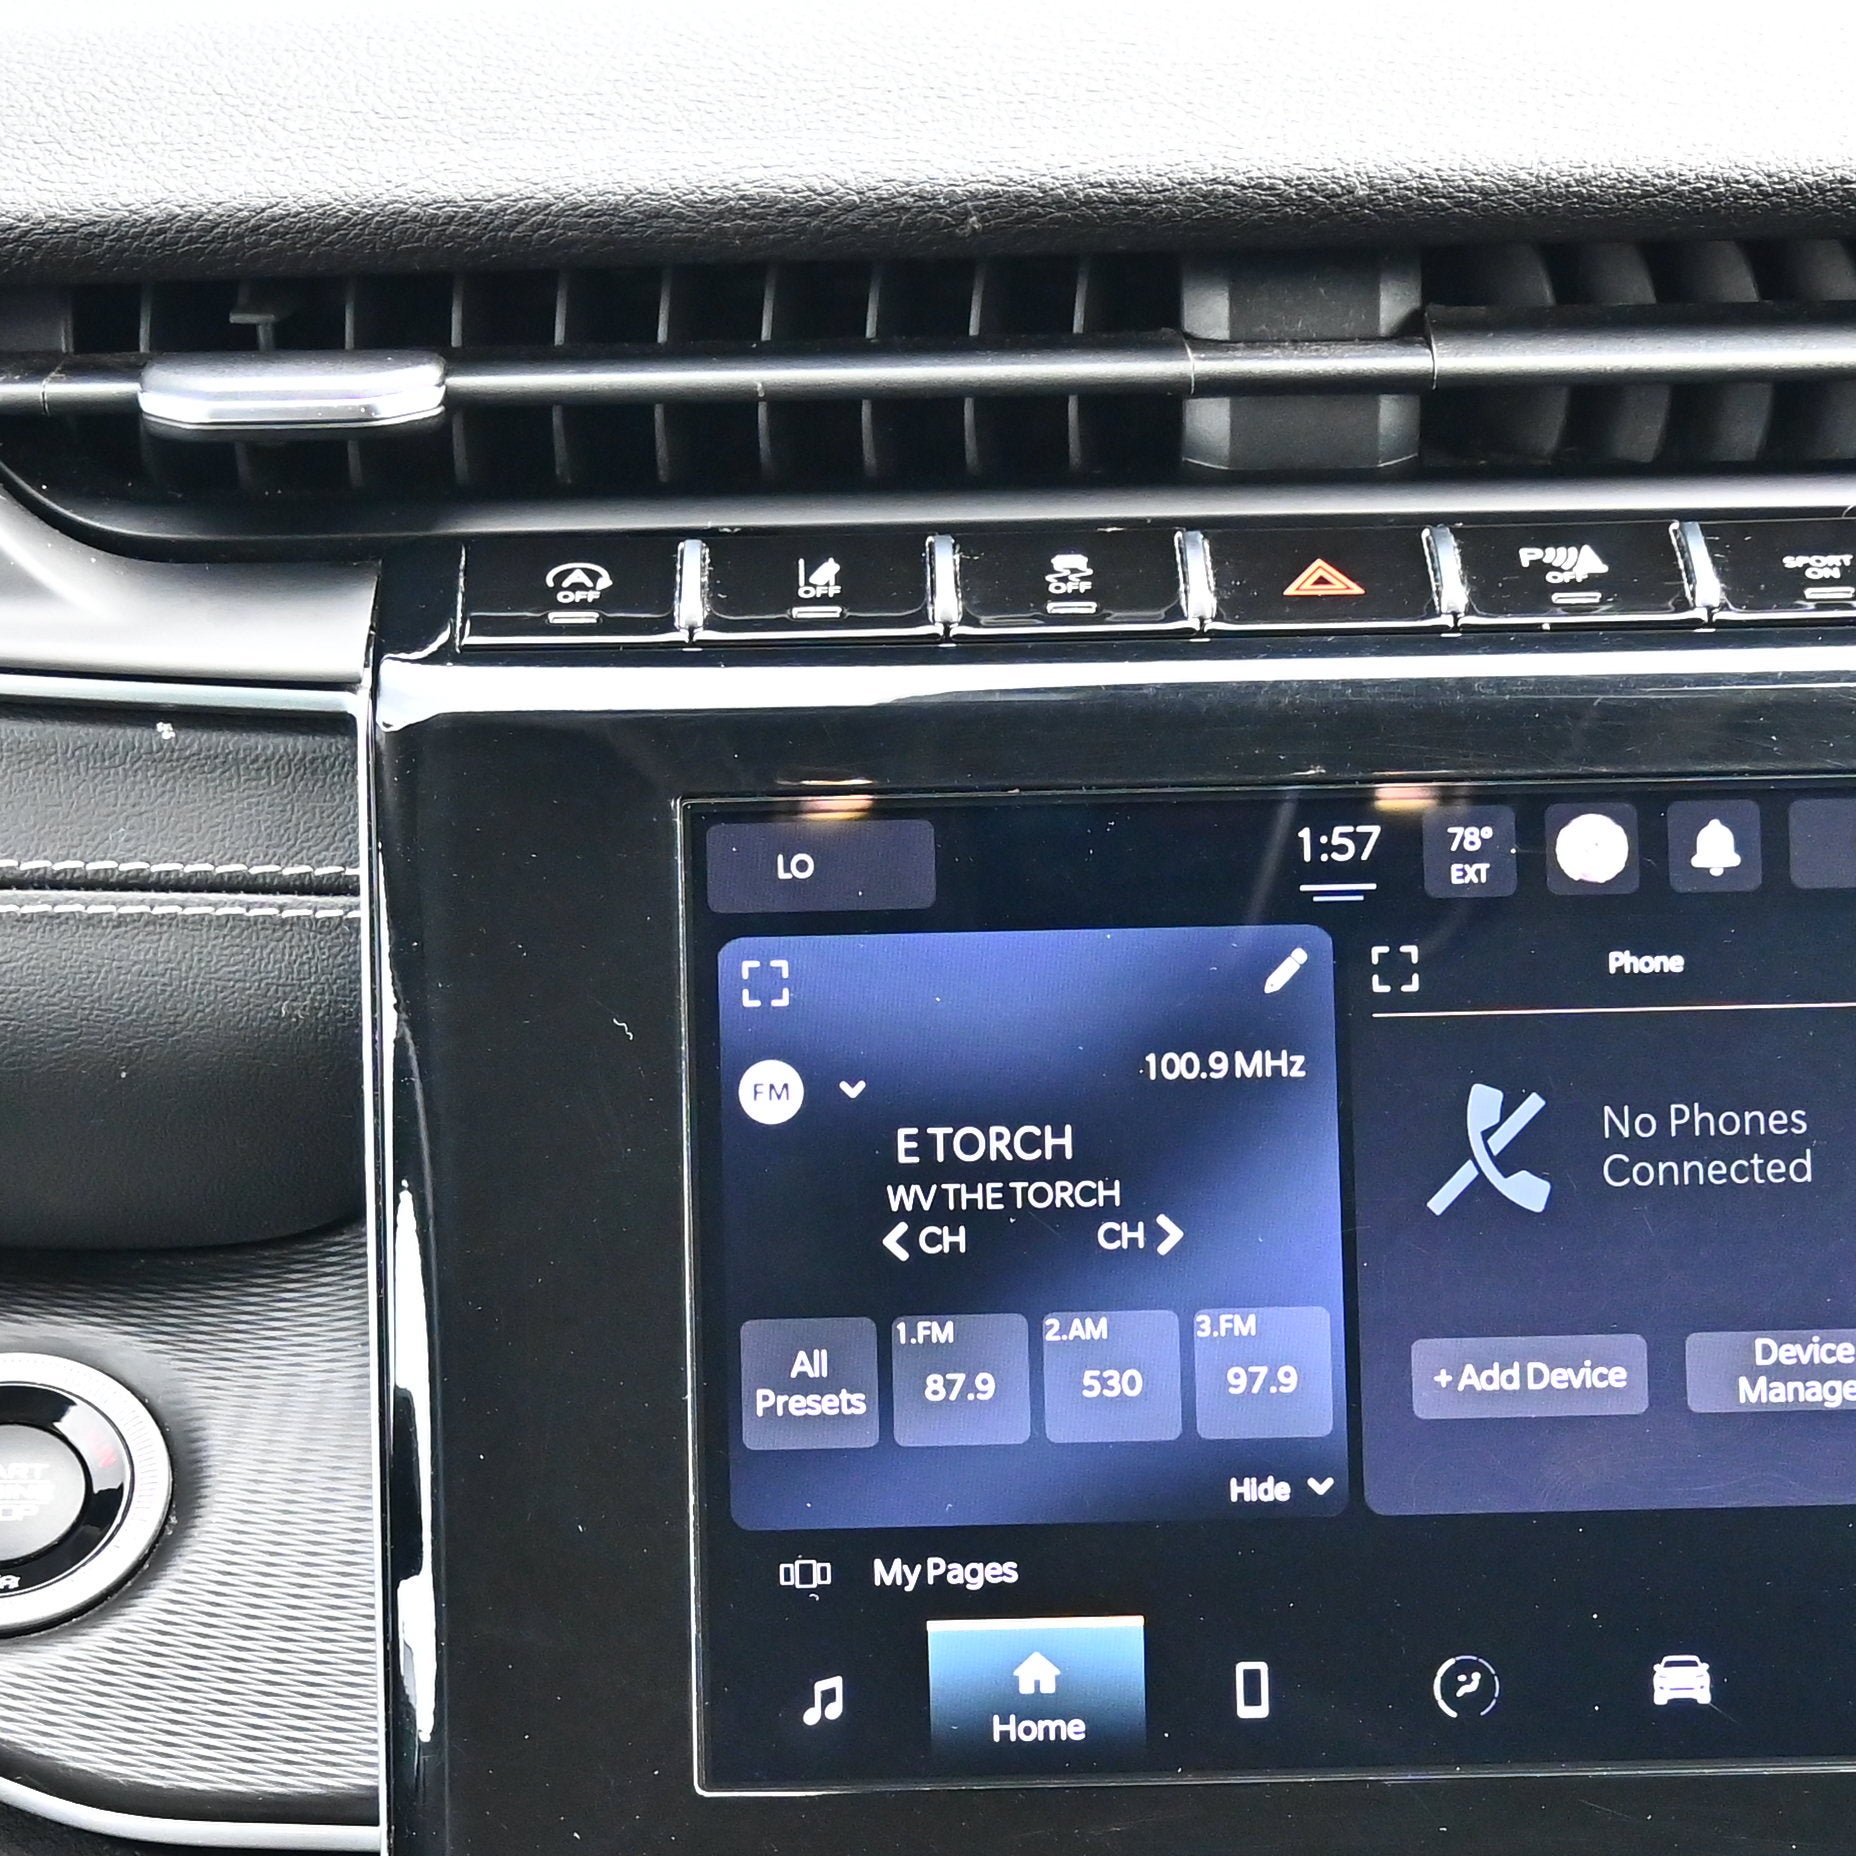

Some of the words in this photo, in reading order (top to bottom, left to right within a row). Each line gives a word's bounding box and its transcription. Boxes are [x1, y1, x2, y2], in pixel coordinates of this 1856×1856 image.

[1782, 554, 1853, 568] SPORT
[1805, 567, 1841, 579] ON
[1048, 581, 1092, 594] OFF
[1545, 571, 1588, 583] OFF
[557, 591, 600, 603] OFF
[798, 585, 841, 599] OFF
[1297, 825, 1381, 865] 1:57
[777, 854, 814, 880] LO
[1451, 863, 1489, 885] EXT
[1608, 950, 1684, 975] Phone
[1144, 1051, 1228, 1081] 100.9
[1234, 1049, 1306, 1078] MHz
[752, 1082, 791, 1103] FM
[1602, 1106, 1657, 1140] No
[1669, 1103, 1808, 1137] Phones
[897, 1127, 918, 1164] E
[928, 1124, 1074, 1162] TORCH
[1602, 1149, 1813, 1188] Connected
[942, 1182, 1005, 1211] THE
[1009, 1179, 1121, 1209] TORCH
[918, 1226, 966, 1255] CH
[1097, 1222, 1145, 1250] CH
[896, 1321, 954, 1345] 1.FM
[1044, 1317, 1108, 1342] 2.AM
[1196, 1314, 1257, 1339] 3.FM
[790, 1350, 828, 1379] All
[1755, 1336, 1856, 1366] Device
[924, 1372, 996, 1402] 87.9
[1081, 1369, 1143, 1398] 530
[1227, 1366, 1298, 1395] 97.9
[1458, 1362, 1520, 1392] Add
[1527, 1358, 1628, 1390] Device
[756, 1387, 866, 1418] Presets
[1229, 1476, 1291, 1504] Hide
[873, 1558, 920, 1592] My
[927, 1556, 1019, 1591] Pages
[992, 1715, 1086, 1743] Home
